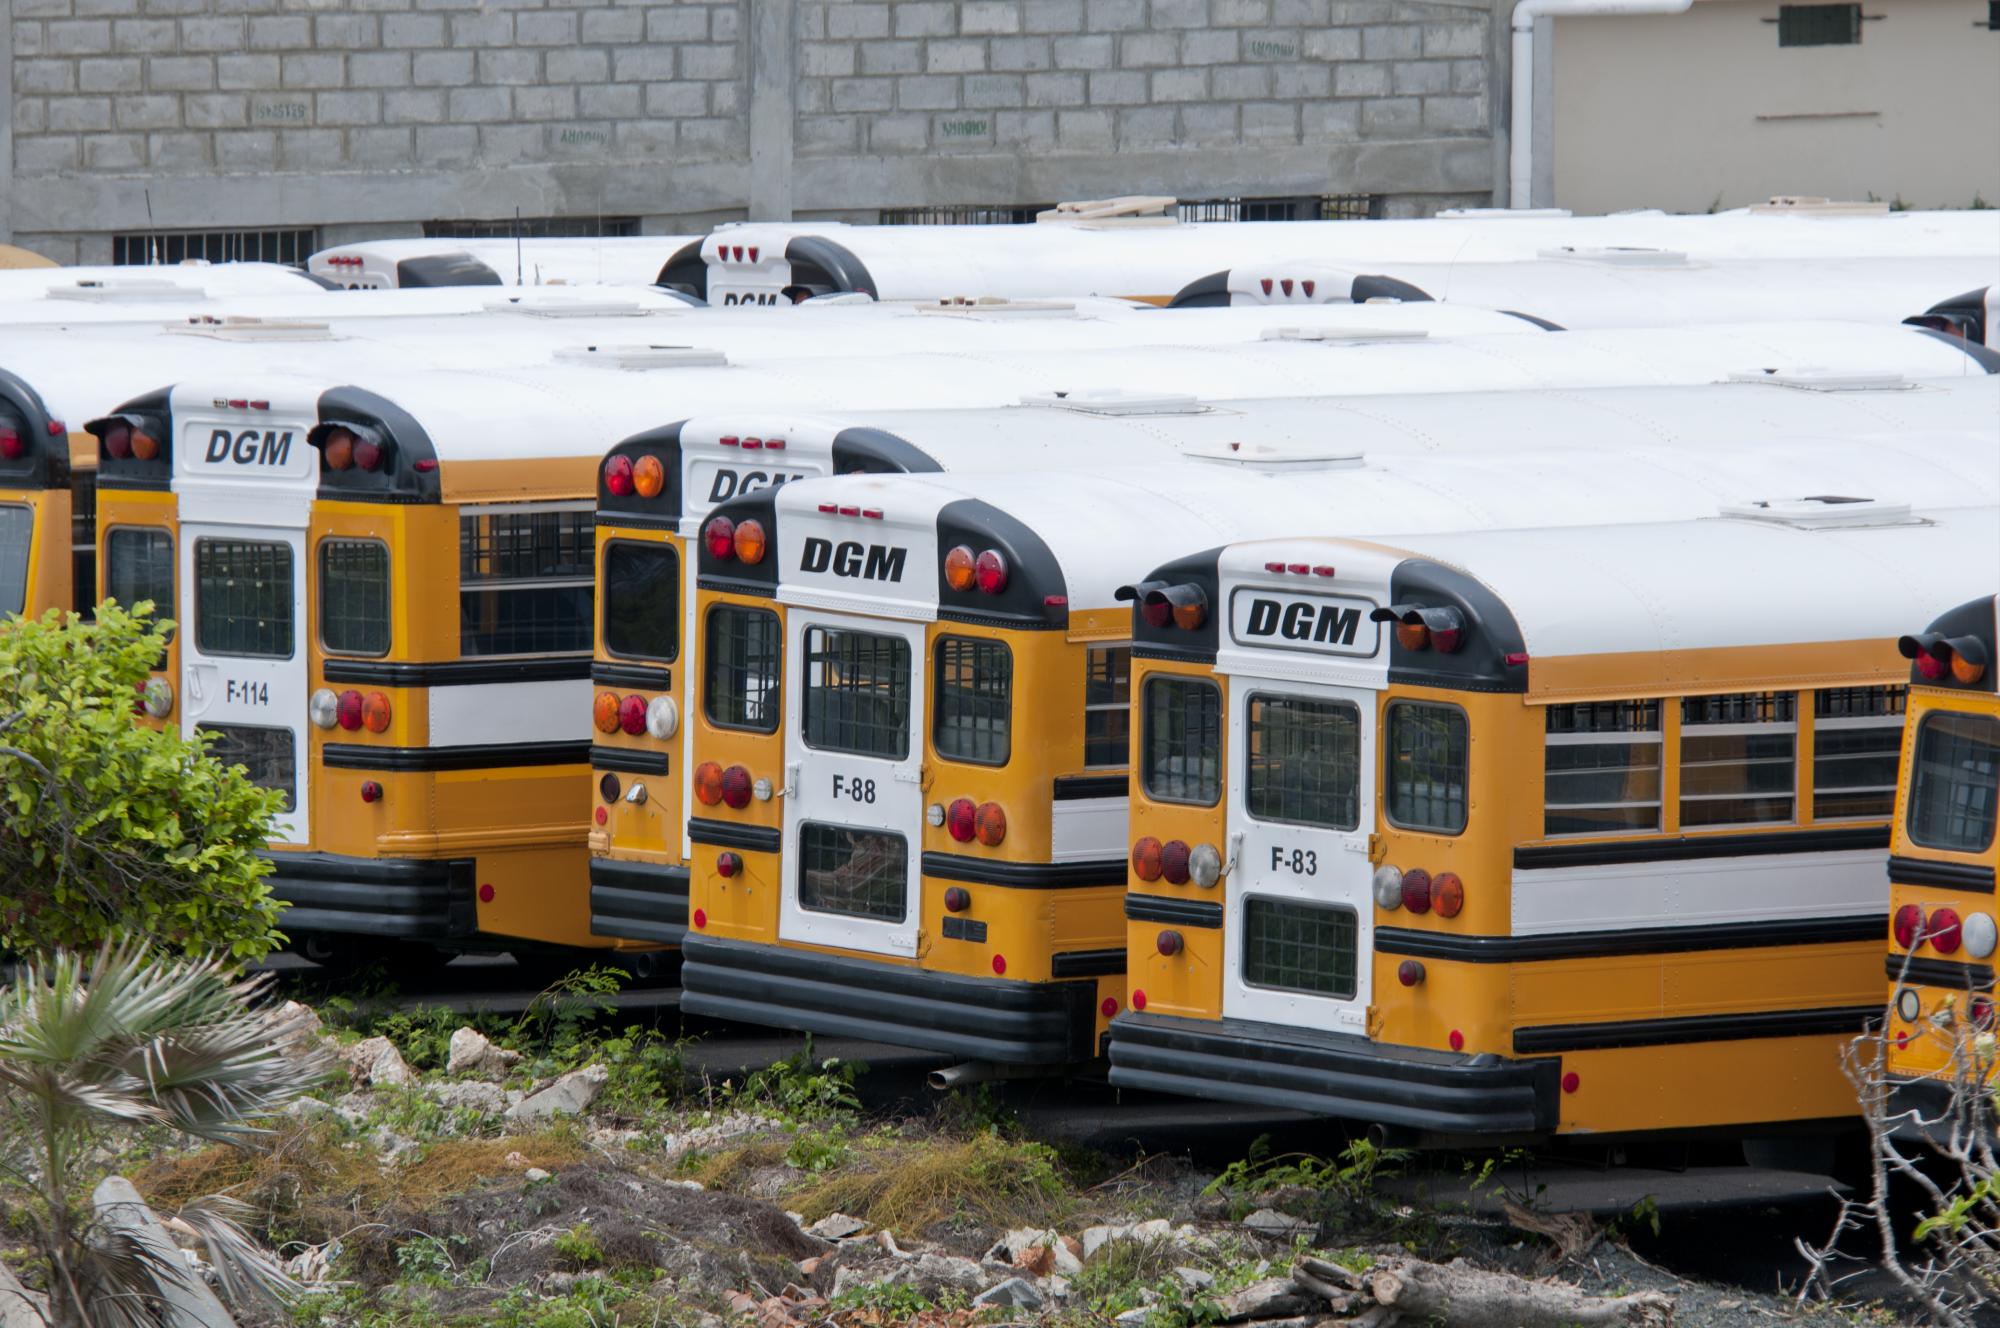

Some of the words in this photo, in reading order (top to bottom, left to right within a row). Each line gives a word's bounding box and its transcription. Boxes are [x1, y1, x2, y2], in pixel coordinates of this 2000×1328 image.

[205, 429, 293, 466] DGM
[708, 468, 804, 503] DG
[800, 536, 907, 583] DGM
[1246, 598, 1361, 646] DGM
[227, 679, 268, 706] F-114
[833, 773, 876, 804] F-88
[1271, 846, 1317, 876] F-83
